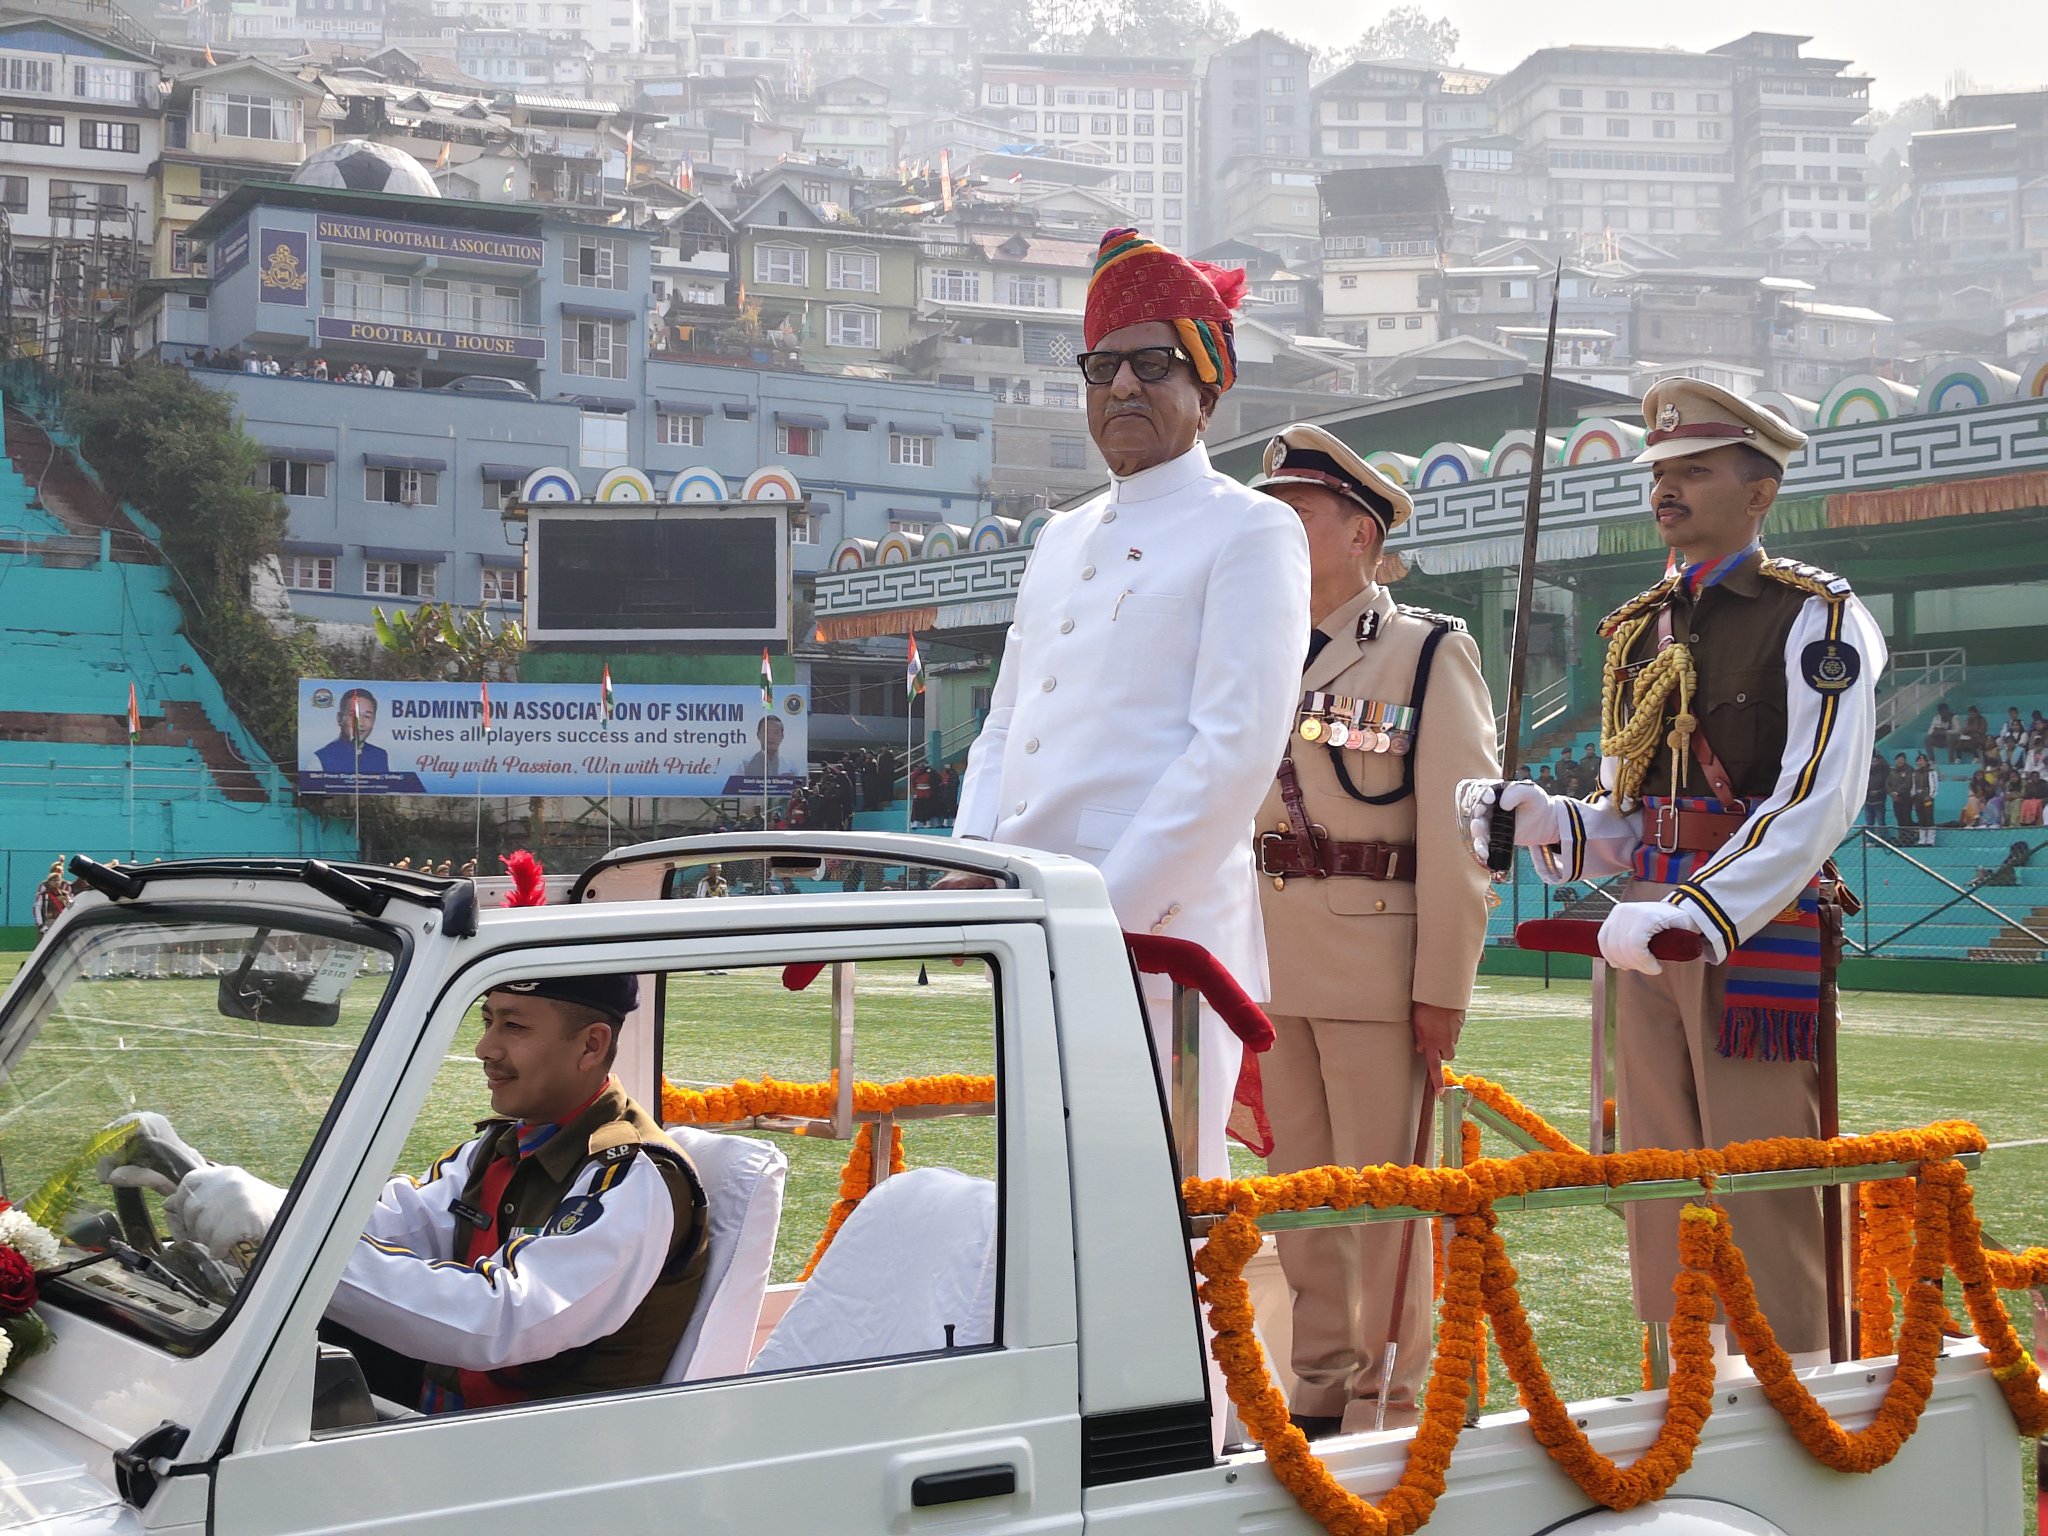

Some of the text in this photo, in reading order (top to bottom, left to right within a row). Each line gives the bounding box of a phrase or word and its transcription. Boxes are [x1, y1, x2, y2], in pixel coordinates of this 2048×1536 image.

[319, 221, 541, 261] SIKKIM FOOTBALL ASSOCIATION
[351, 323, 515, 353] FOOTBALL HOUSE
[513, 701, 642, 721] ASSOCIAION
[647, 702, 672, 721] OF
[676, 702, 744, 721] SIKKIM
[392, 725, 747, 748] wishes all players success and strength
[416, 754, 459, 779] Play
[624, 757, 660, 774] with
[664, 757, 721, 775] Pride!
